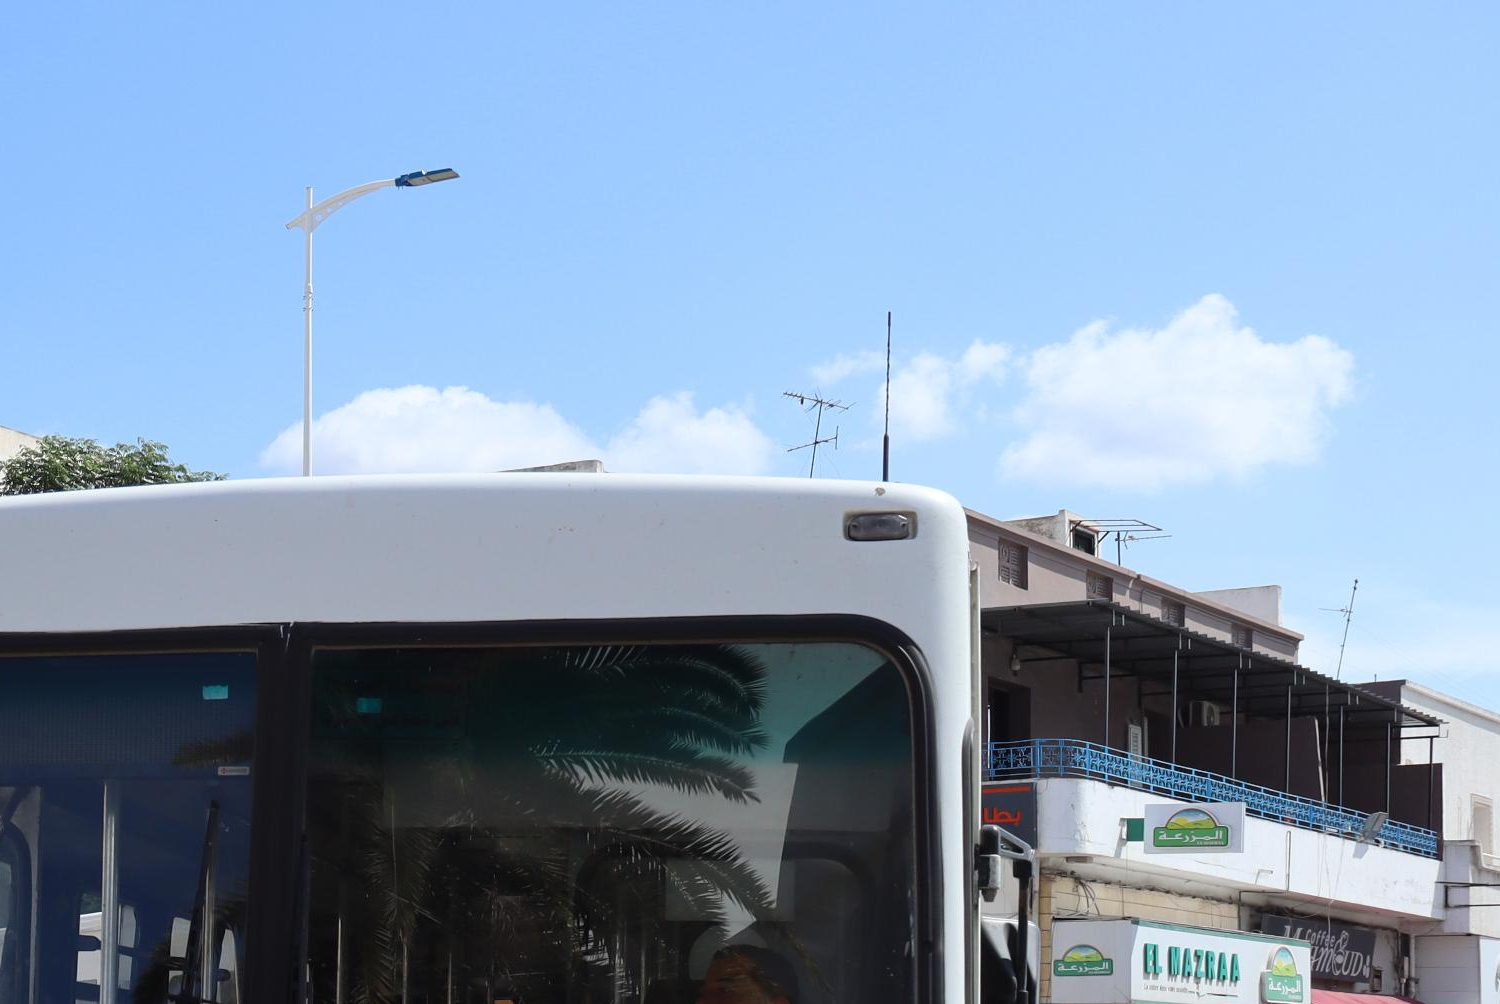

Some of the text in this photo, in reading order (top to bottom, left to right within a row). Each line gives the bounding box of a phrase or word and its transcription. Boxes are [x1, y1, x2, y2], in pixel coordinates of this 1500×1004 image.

[1158, 829, 1223, 843] المزرعة
[1057, 962, 1109, 973] المزرعة
[1144, 943, 1241, 982] EL MAZRAA
[1268, 977, 1301, 995] المزرعة
